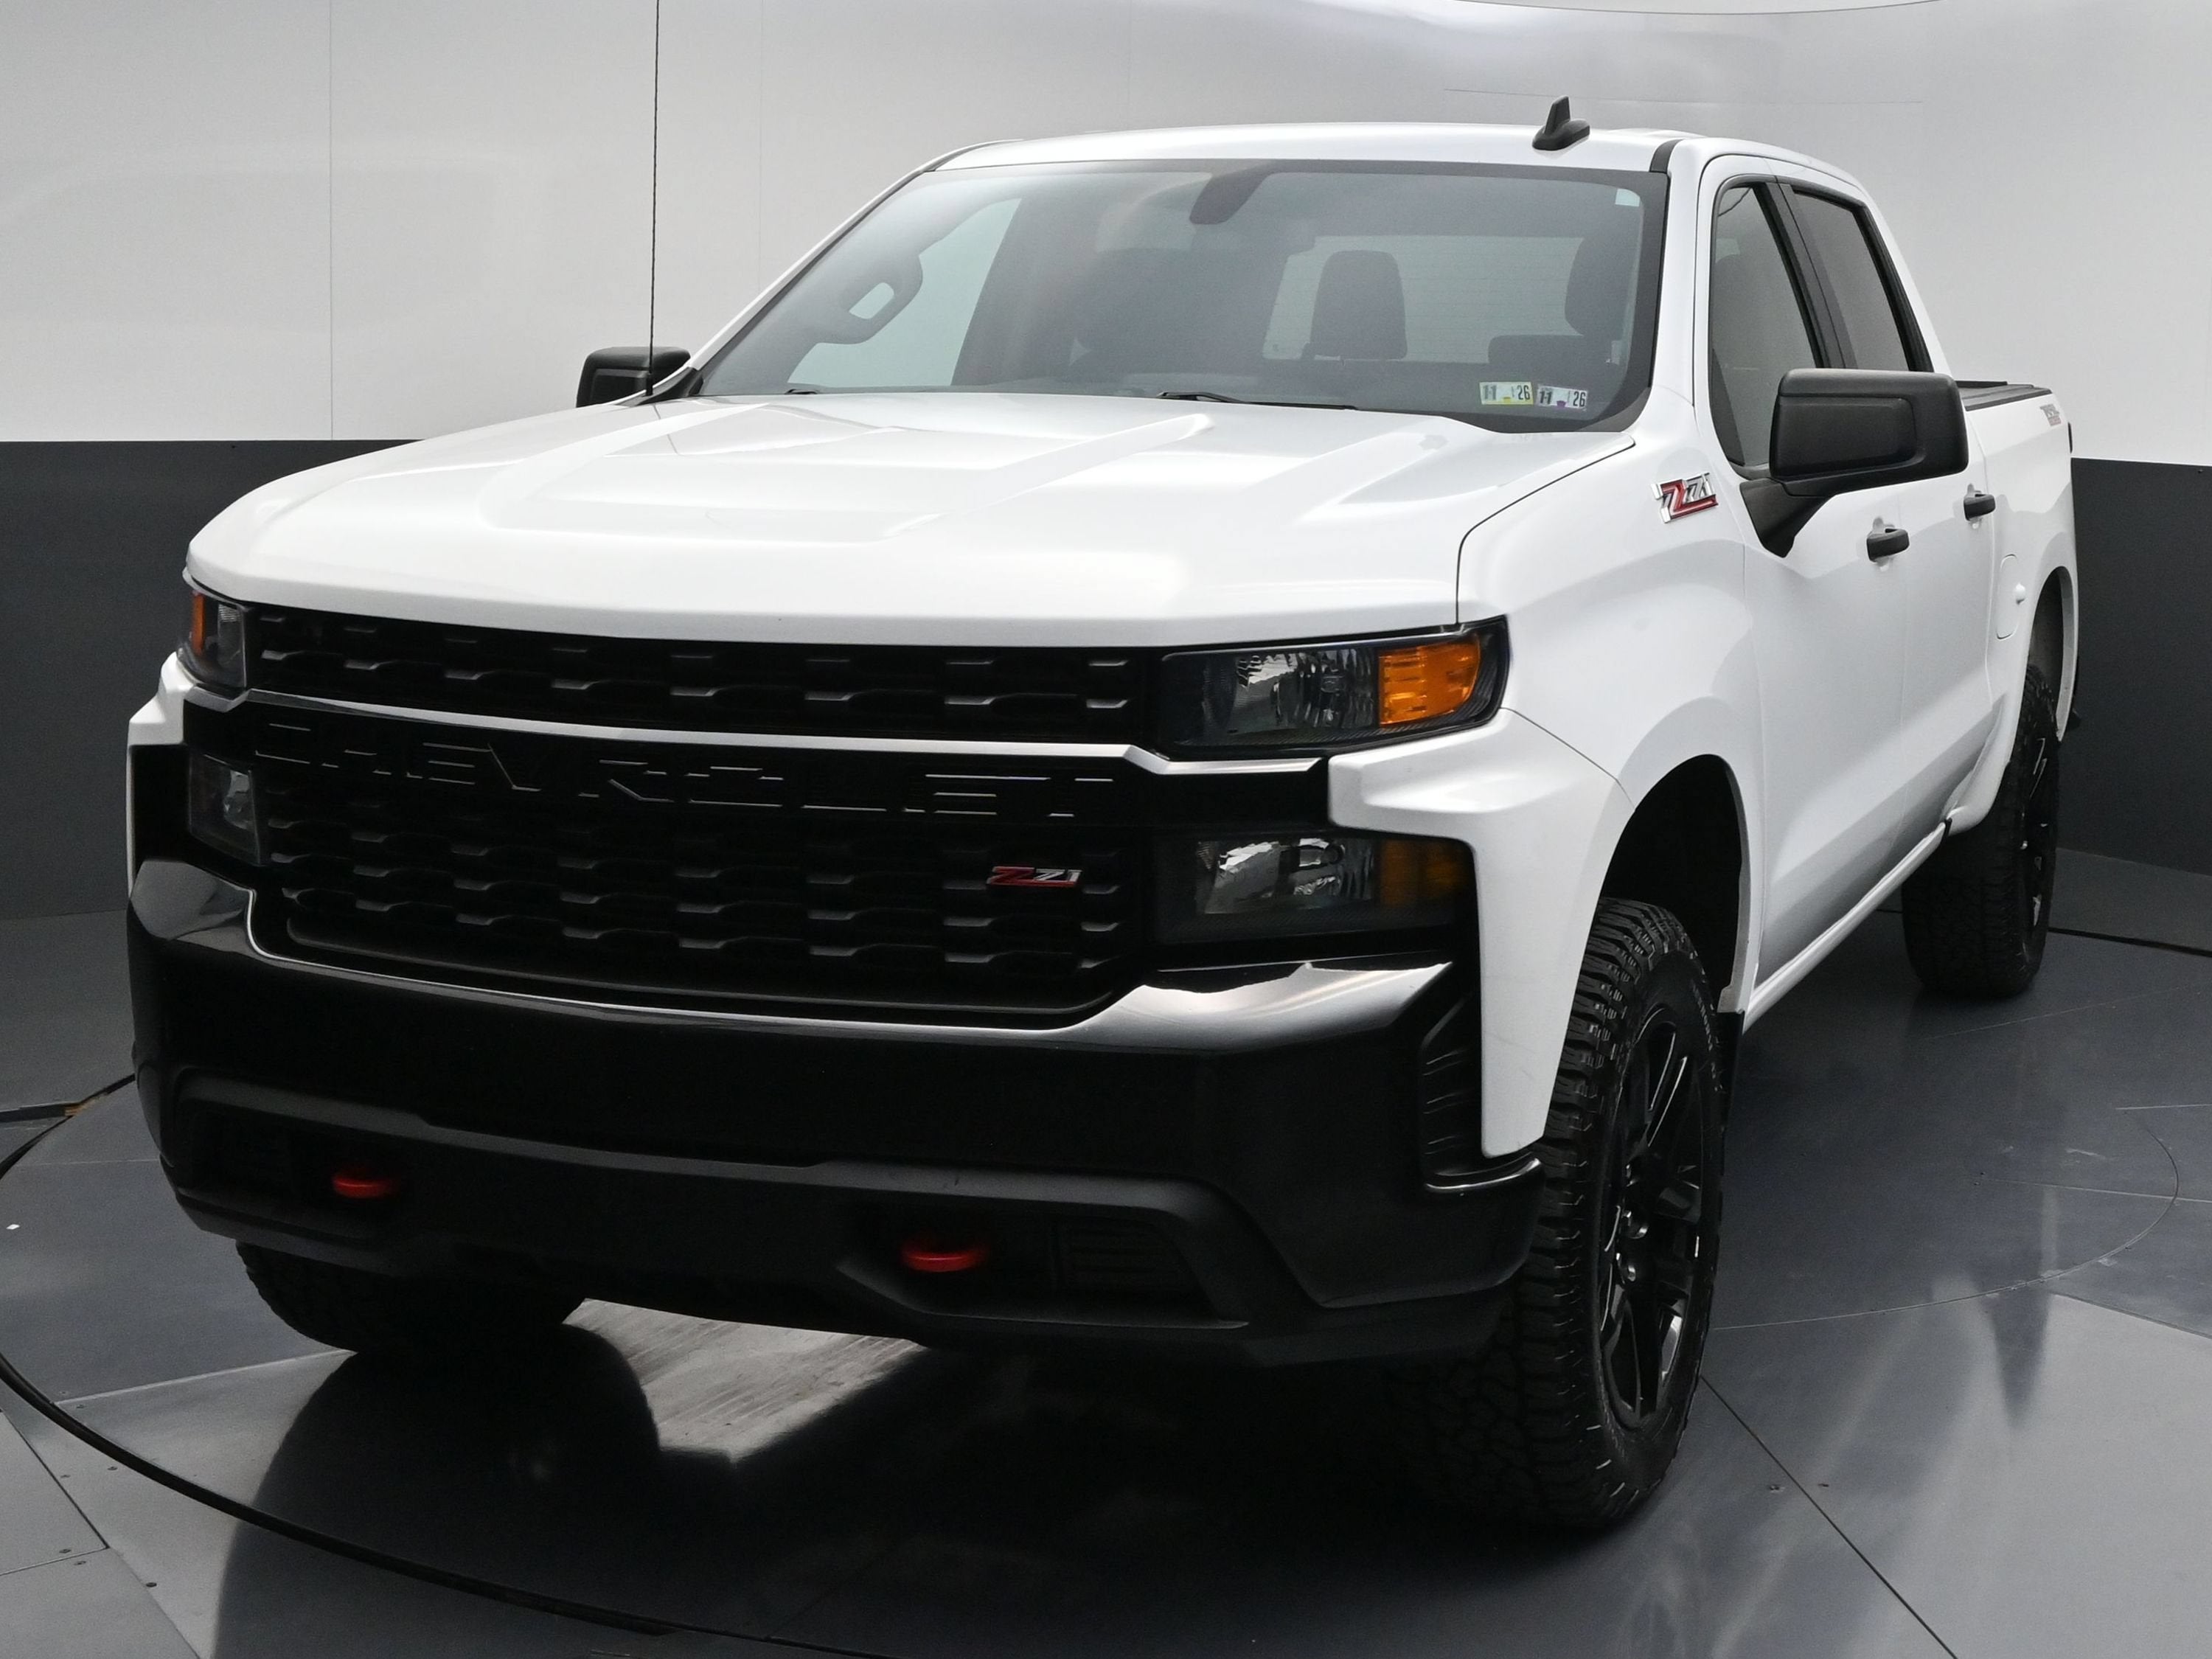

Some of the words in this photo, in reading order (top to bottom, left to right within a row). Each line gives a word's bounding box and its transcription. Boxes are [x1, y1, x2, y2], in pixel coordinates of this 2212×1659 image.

[1517, 384, 1531, 400] 26
[1573, 391, 1586, 407] 26
[1651, 472, 1719, 524] Z71
[986, 866, 1082, 888] Z71
